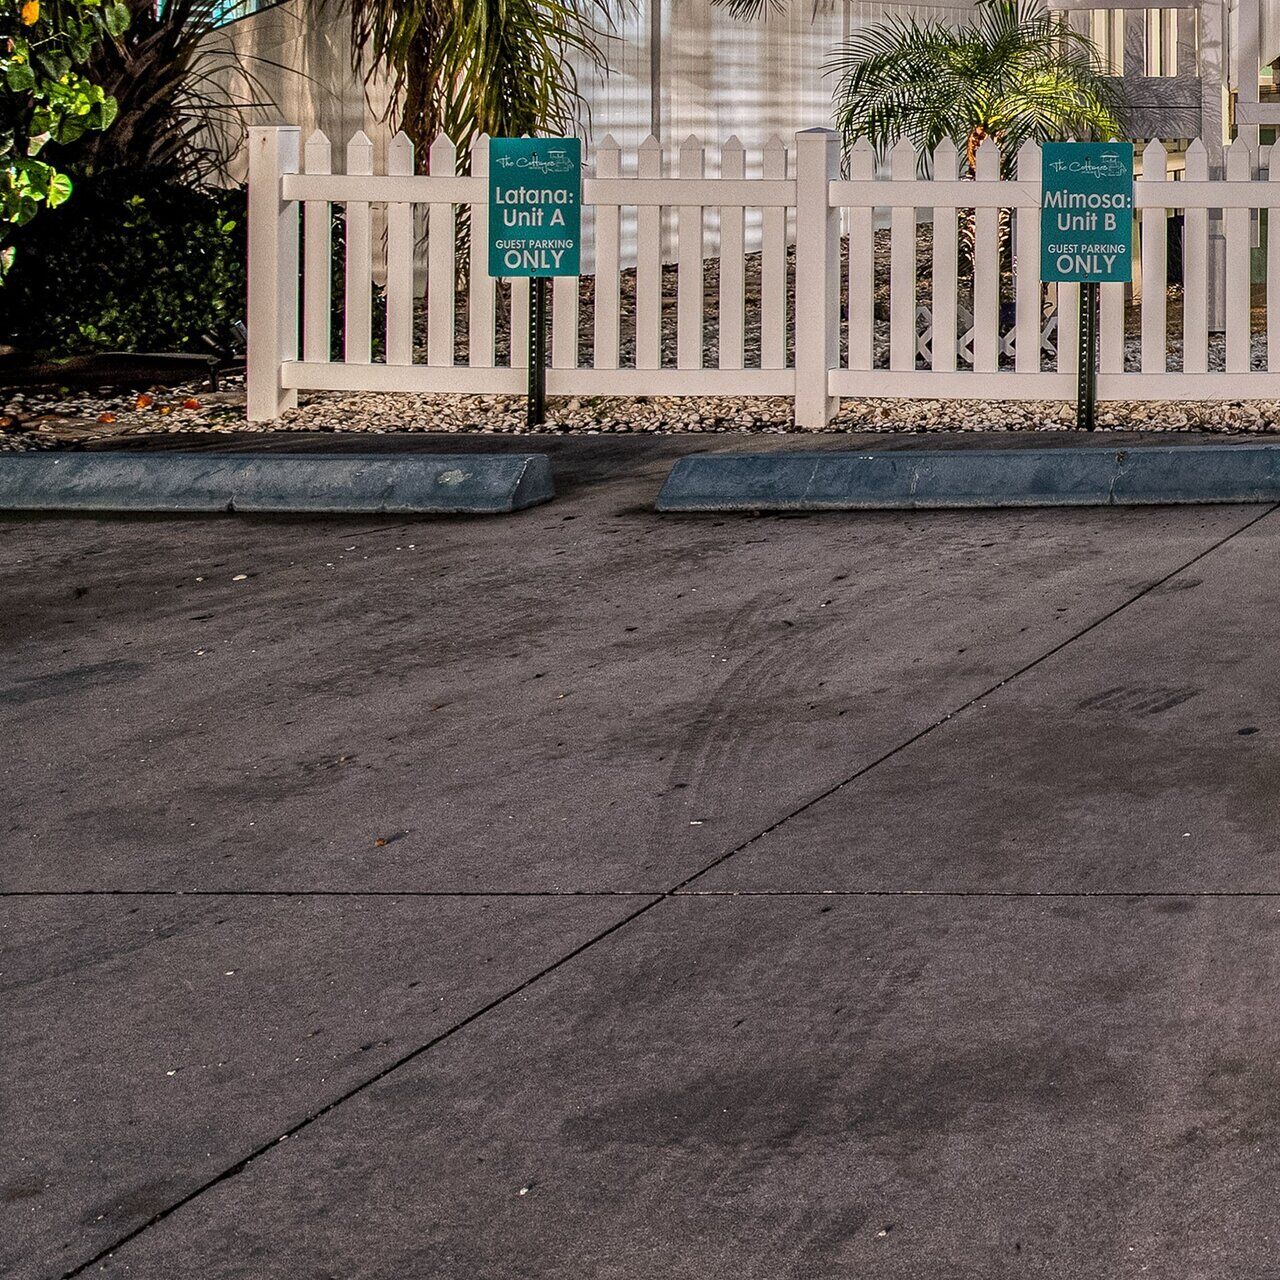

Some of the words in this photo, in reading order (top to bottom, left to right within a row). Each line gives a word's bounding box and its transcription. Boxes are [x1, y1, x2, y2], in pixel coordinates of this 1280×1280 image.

[496, 155, 513, 168] The
[1050, 160, 1066, 172] The
[496, 187, 574, 204] Latana:
[1044, 190, 1131, 208] Mimosa:
[504, 209, 543, 226] Unit
[550, 209, 565, 226] A
[1058, 213, 1097, 230] Unit
[1105, 214, 1116, 230] B
[496, 240, 525, 249] GUEST
[529, 240, 573, 249] PARKING
[1048, 245, 1078, 253] GUEST
[1082, 245, 1125, 253] PARKING
[504, 250, 564, 268] ONLY
[1057, 255, 1116, 273] ONLY
